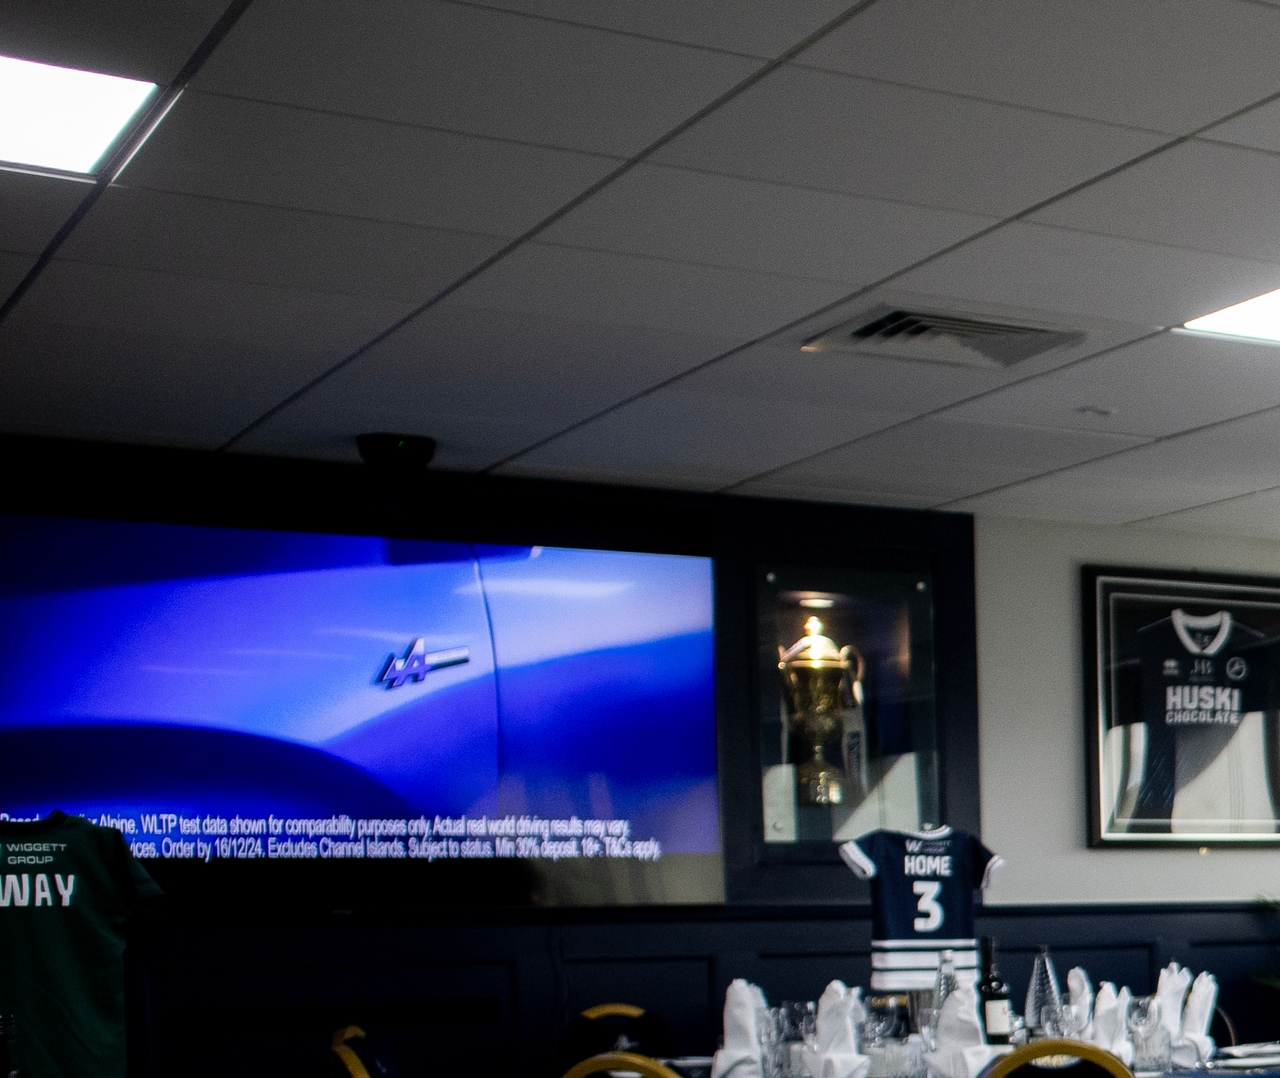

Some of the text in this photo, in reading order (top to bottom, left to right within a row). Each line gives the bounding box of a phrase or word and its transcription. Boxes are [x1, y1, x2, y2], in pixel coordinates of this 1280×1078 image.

[1166, 685, 1241, 711] HUSKI
[1165, 710, 1240, 725] CHOCOLATE
[141, 814, 177, 834] WLTP
[179, 815, 200, 834] test
[202, 814, 228, 834] data
[229, 814, 266, 834] shown
[268, 814, 284, 834] for
[285, 814, 356, 839] comparability
[357, 818, 406, 839] purposes
[433, 815, 465, 836] Actual
[467, 815, 487, 836] real
[488, 815, 516, 836] world
[516, 815, 550, 841] driving
[584, 819, 607, 841] may
[7, 843, 67, 851] WIGGETT
[8, 856, 53, 864] GROUP
[130, 838, 159, 858] ices.
[162, 837, 195, 858] Order
[197, 838, 211, 863] by
[215, 837, 265, 858] 16/12/24.
[267, 837, 317, 858] Excludes
[319, 837, 364, 858] Channel
[366, 837, 406, 858] Islands.
[408, 837, 448, 863] Subject
[448, 838, 460, 858] to
[904, 854, 952, 876] HOME
[0, 873, 75, 907] WAY
[912, 880, 945, 933] 3
